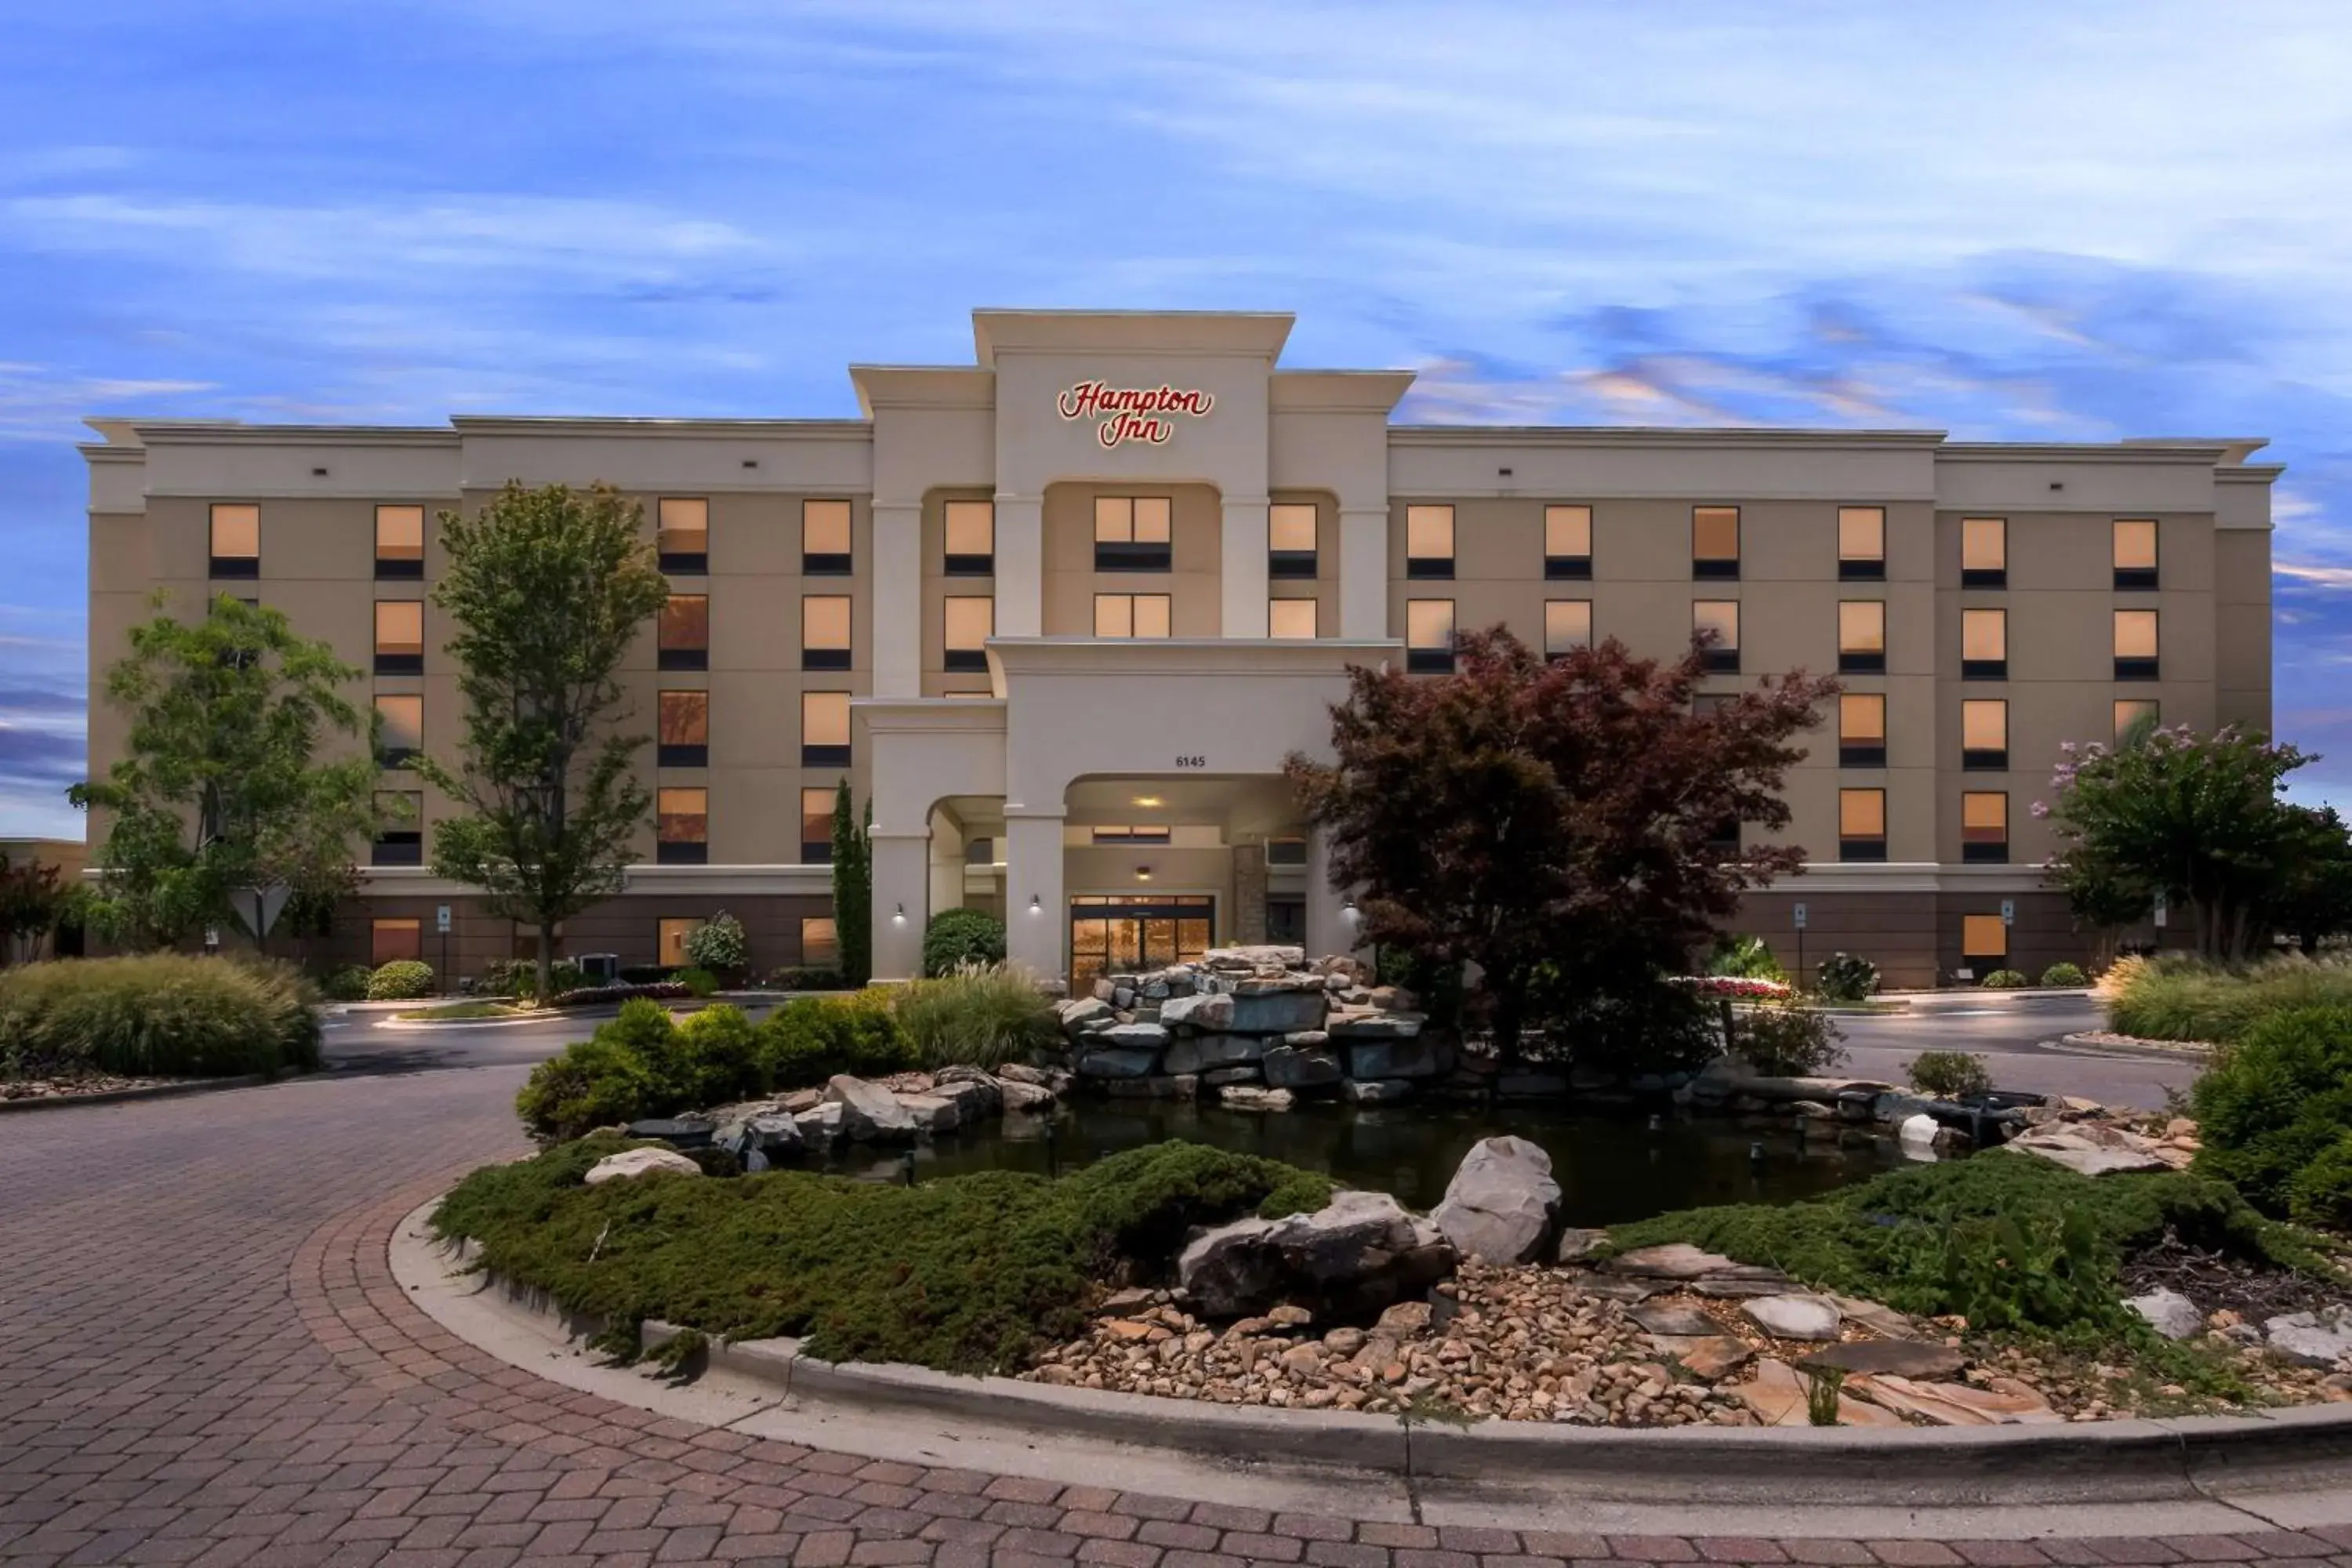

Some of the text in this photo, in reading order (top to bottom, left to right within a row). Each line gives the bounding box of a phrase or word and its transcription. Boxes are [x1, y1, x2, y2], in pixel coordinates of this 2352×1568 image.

[1058, 381, 1214, 420] Hampton
[1099, 412, 1172, 448] Inn
[1176, 756, 1205, 768] 6145
